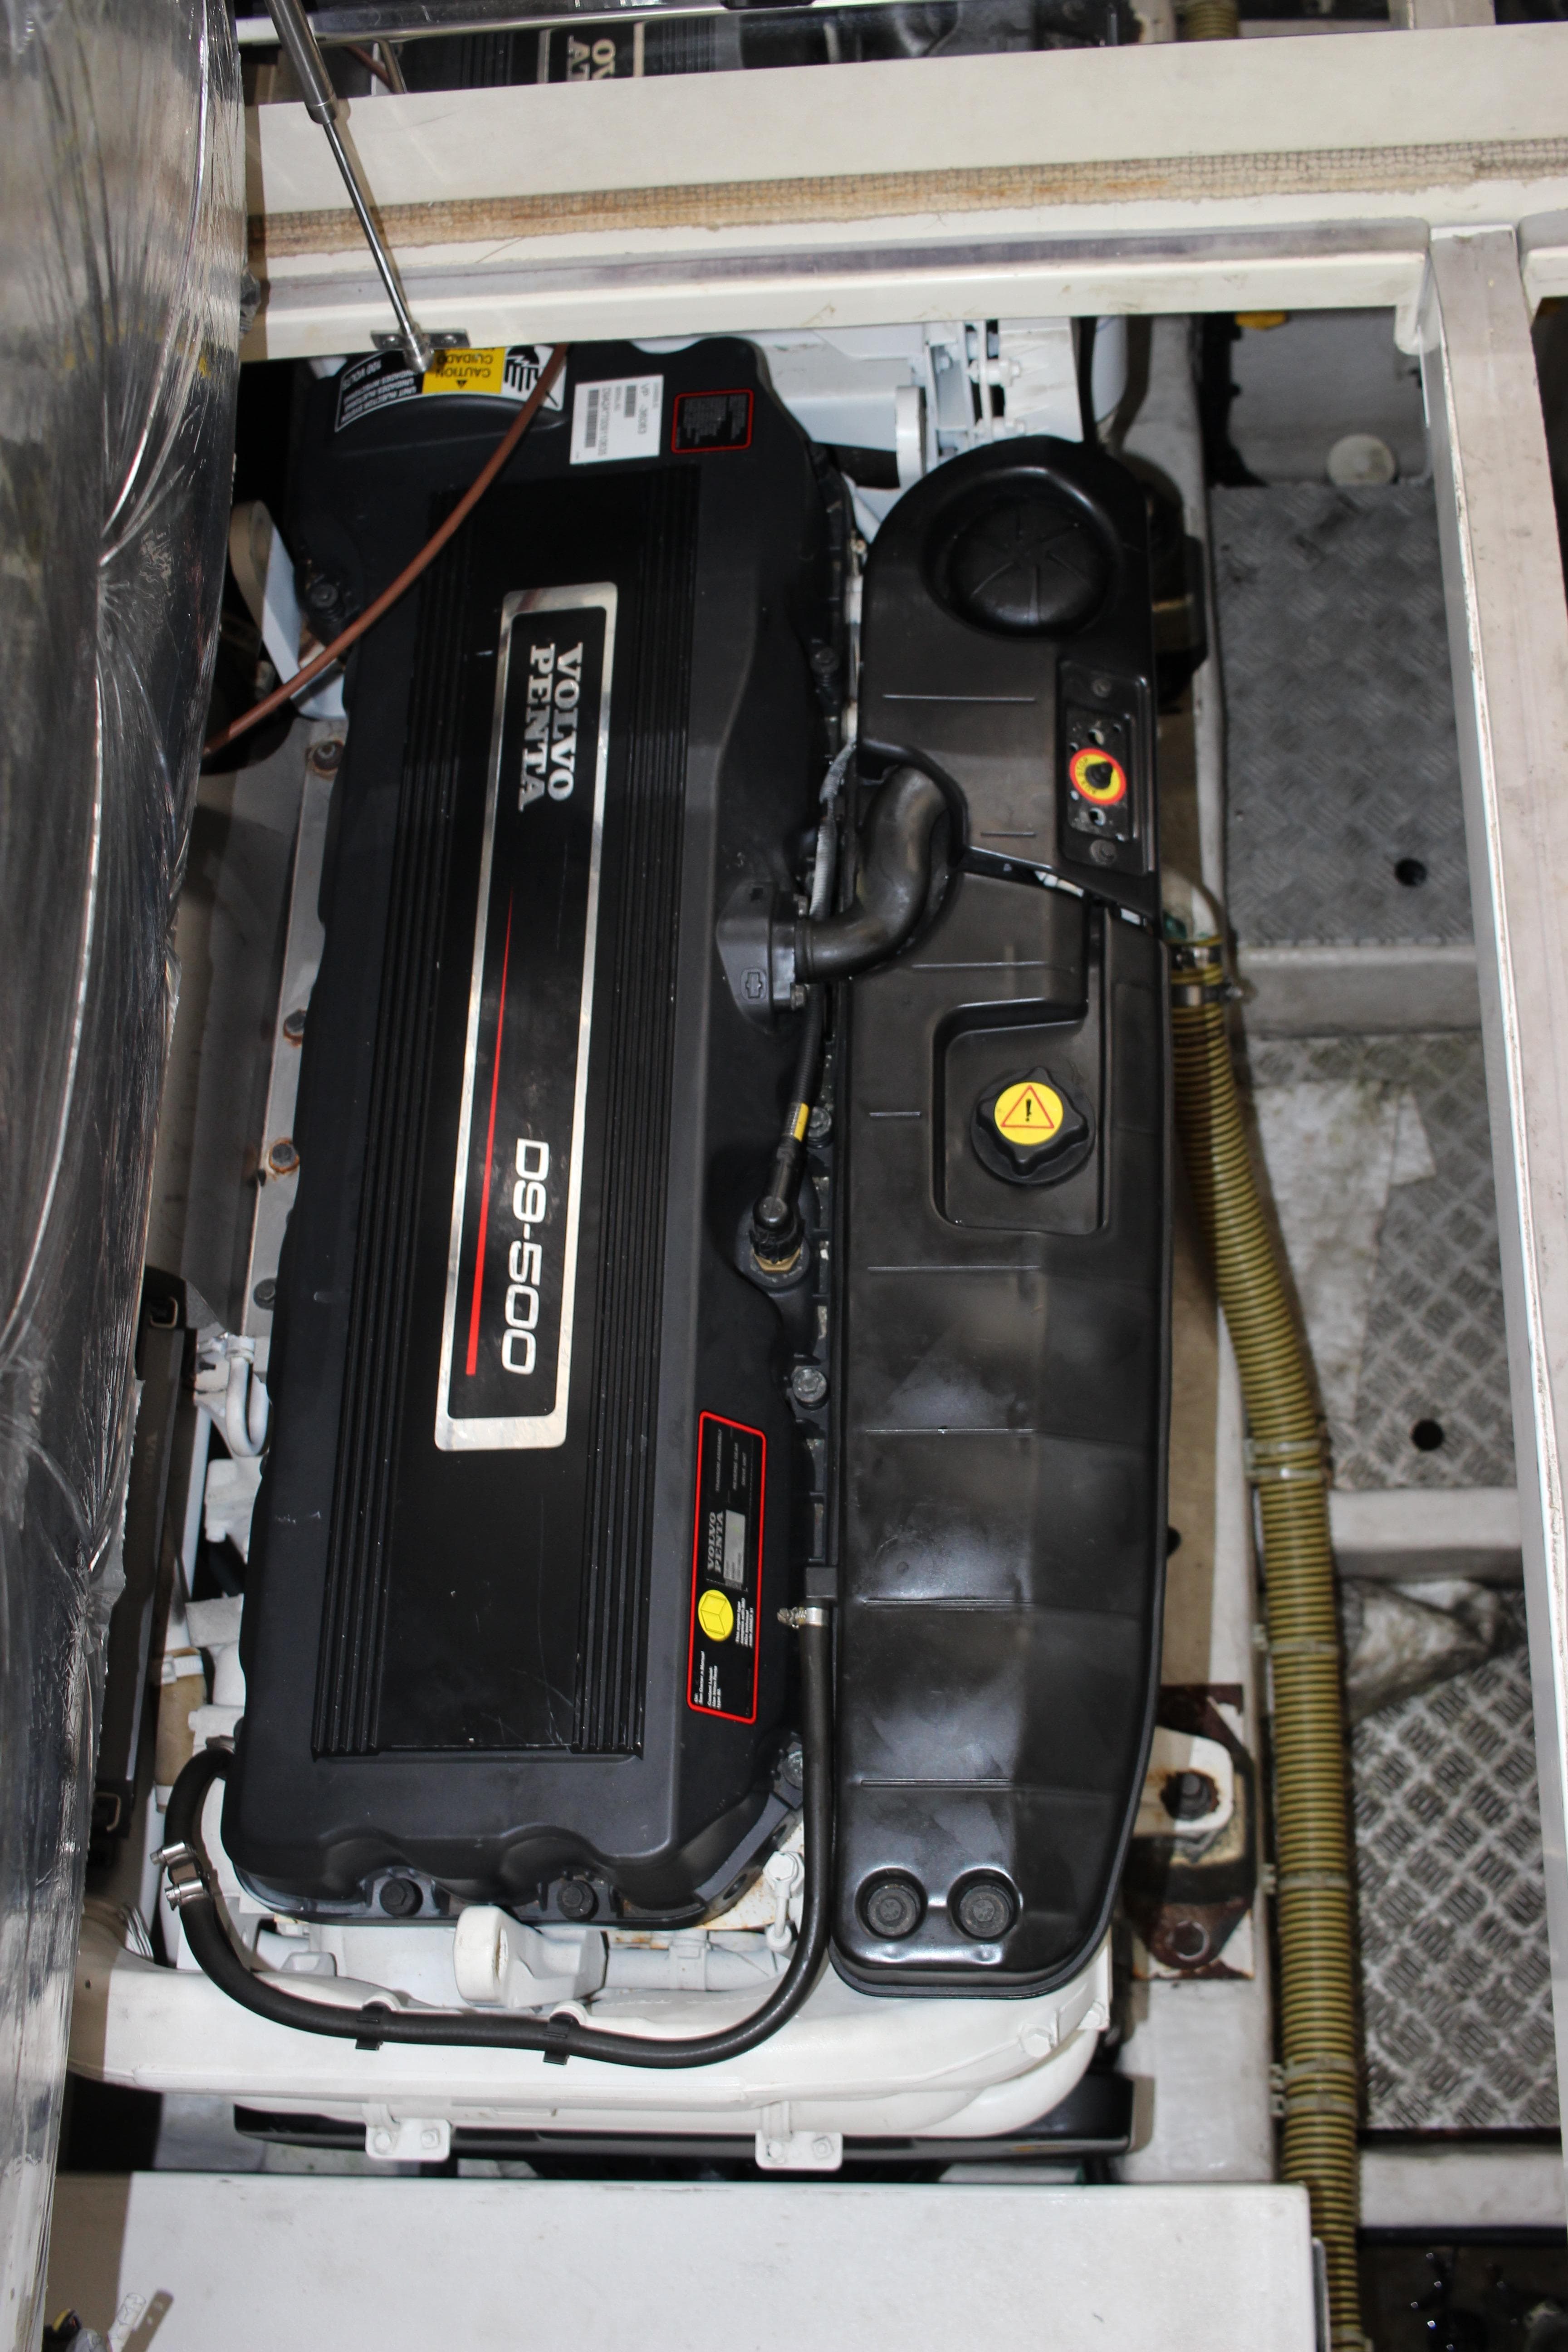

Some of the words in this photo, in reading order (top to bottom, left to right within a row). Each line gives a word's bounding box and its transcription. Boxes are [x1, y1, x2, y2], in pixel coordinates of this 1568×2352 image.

[436, 354, 493, 365] CUIDADO
[436, 368, 491, 378] CAUTION
[518, 642, 555, 812] PENTA
[548, 642, 583, 801] VOLVO
[501, 1138, 549, 1375] D9-500
[707, 1512, 716, 1570] VOLVO
[715, 1511, 723, 1573] PENTA
